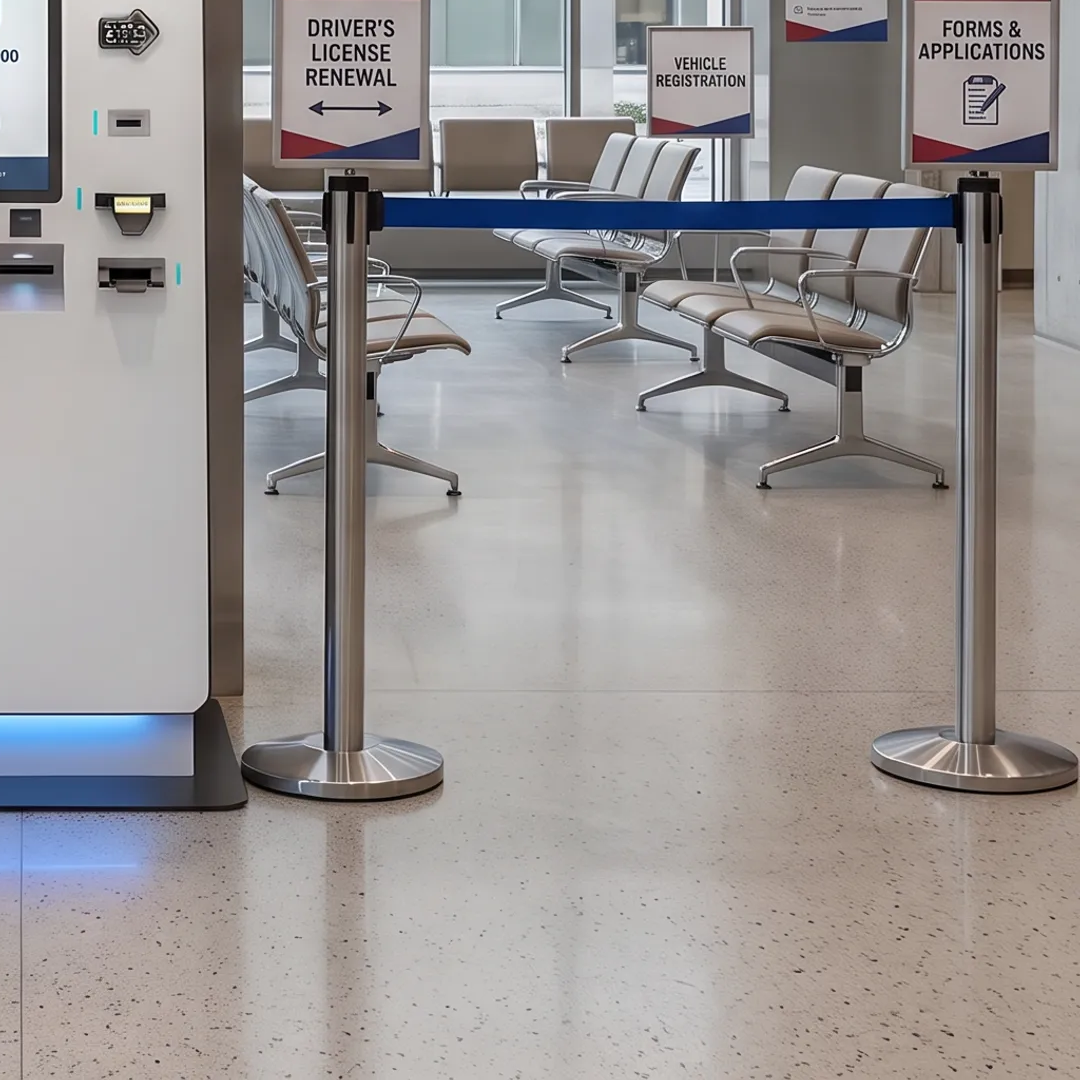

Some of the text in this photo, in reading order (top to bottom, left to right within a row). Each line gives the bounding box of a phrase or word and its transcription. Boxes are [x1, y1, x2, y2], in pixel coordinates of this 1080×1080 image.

[308, 18, 395, 38] DRIVER'S
[942, 20, 1021, 38] FORMS &
[312, 43, 392, 62] LICENSE
[918, 42, 1045, 61] APPLICATIONS
[674, 56, 727, 71] VEHICLE
[305, 68, 397, 87] RENEWAL
[655, 74, 746, 88] REGISTRATION
